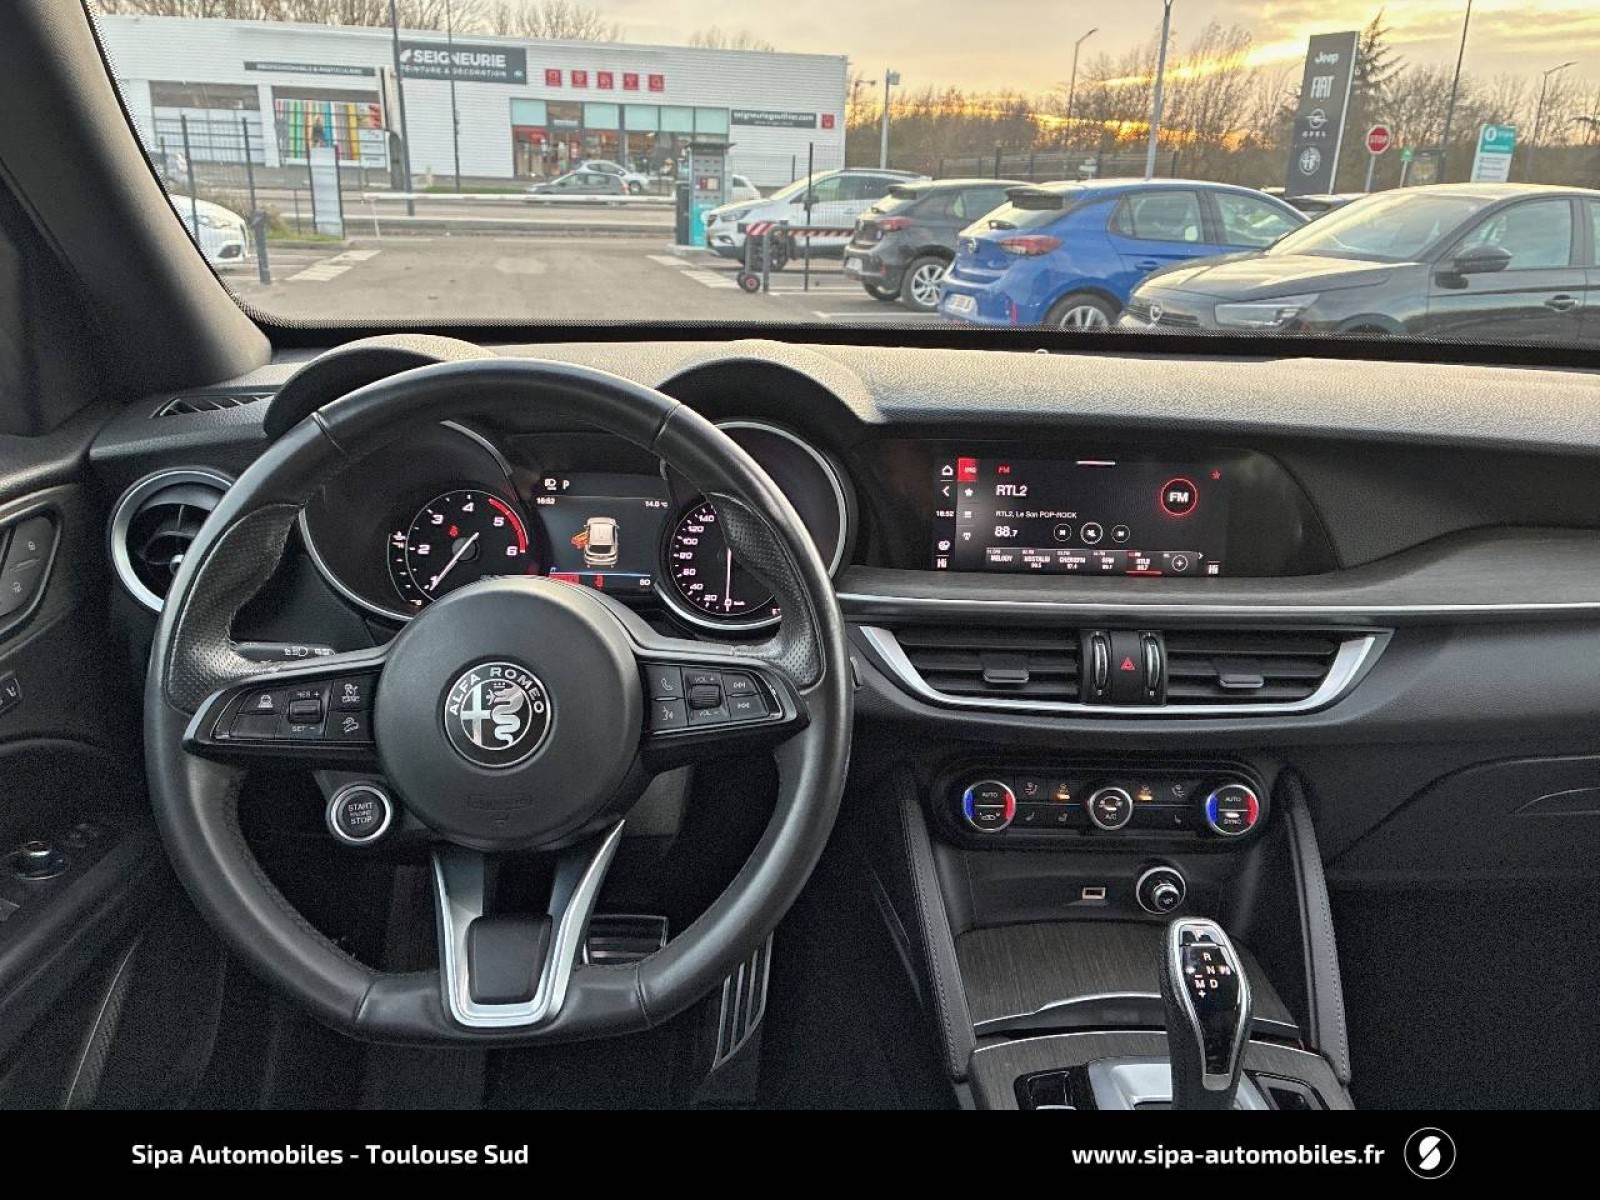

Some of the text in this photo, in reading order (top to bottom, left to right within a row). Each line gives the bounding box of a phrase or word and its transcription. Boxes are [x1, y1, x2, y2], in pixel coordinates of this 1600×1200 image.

[413, 49, 506, 67] SEIGNEURIE
[1315, 52, 1339, 65] Jeep
[1310, 76, 1335, 98] FIAT
[995, 484, 1028, 497] RTL2
[1169, 491, 1189, 503] FM
[462, 502, 474, 512] 4
[431, 514, 443, 525] 3
[493, 516, 504, 526] 5
[994, 525, 1018, 538] 88.7
[417, 544, 430, 555] 2
[506, 546, 518, 556] 6
[449, 666, 545, 716] ALFA ROMEO
[348, 802, 373, 812] START
[350, 816, 372, 825] STOP
[1203, 952, 1212, 961] R
[1206, 965, 1216, 975] N
[1194, 979, 1206, 989] M
[1209, 979, 1219, 989] D
